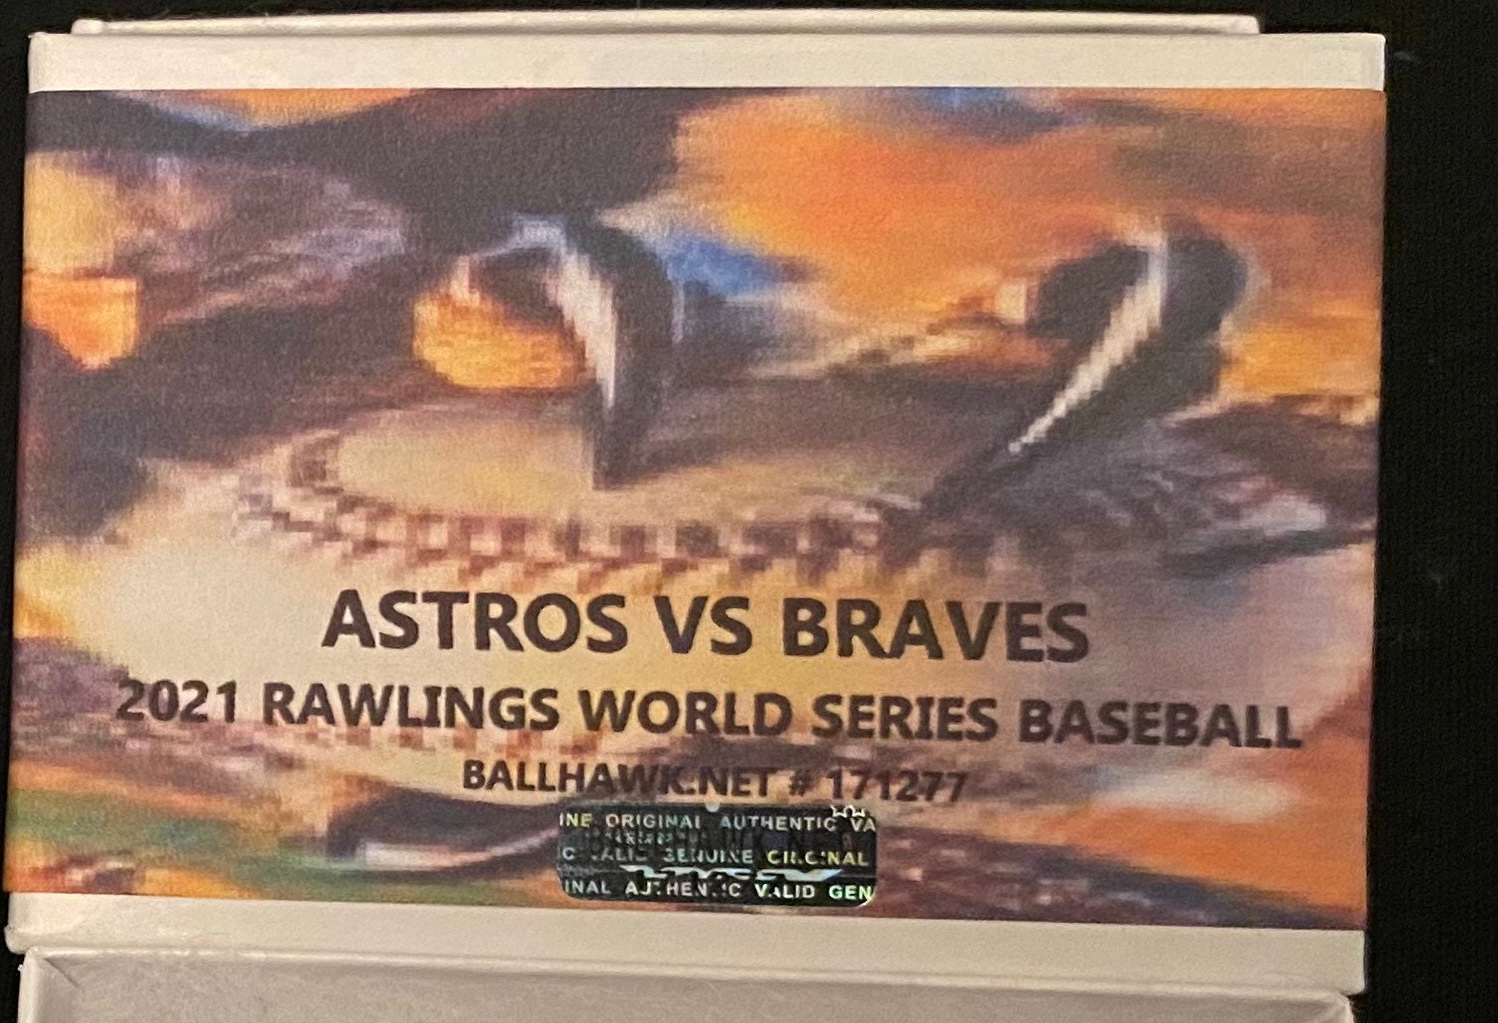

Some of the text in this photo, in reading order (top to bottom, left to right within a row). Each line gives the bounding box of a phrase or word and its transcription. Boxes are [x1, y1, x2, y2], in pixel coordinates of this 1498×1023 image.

[321, 589, 1090, 663] ASTROS VS BRAVES
[116, 679, 1304, 750] 2021 RAWLINGS WORLD SERIES BASEBALL
[462, 759, 969, 803] BALLHAWK.NET # 171277
[719, 815, 838, 832] AUTHENTIC
